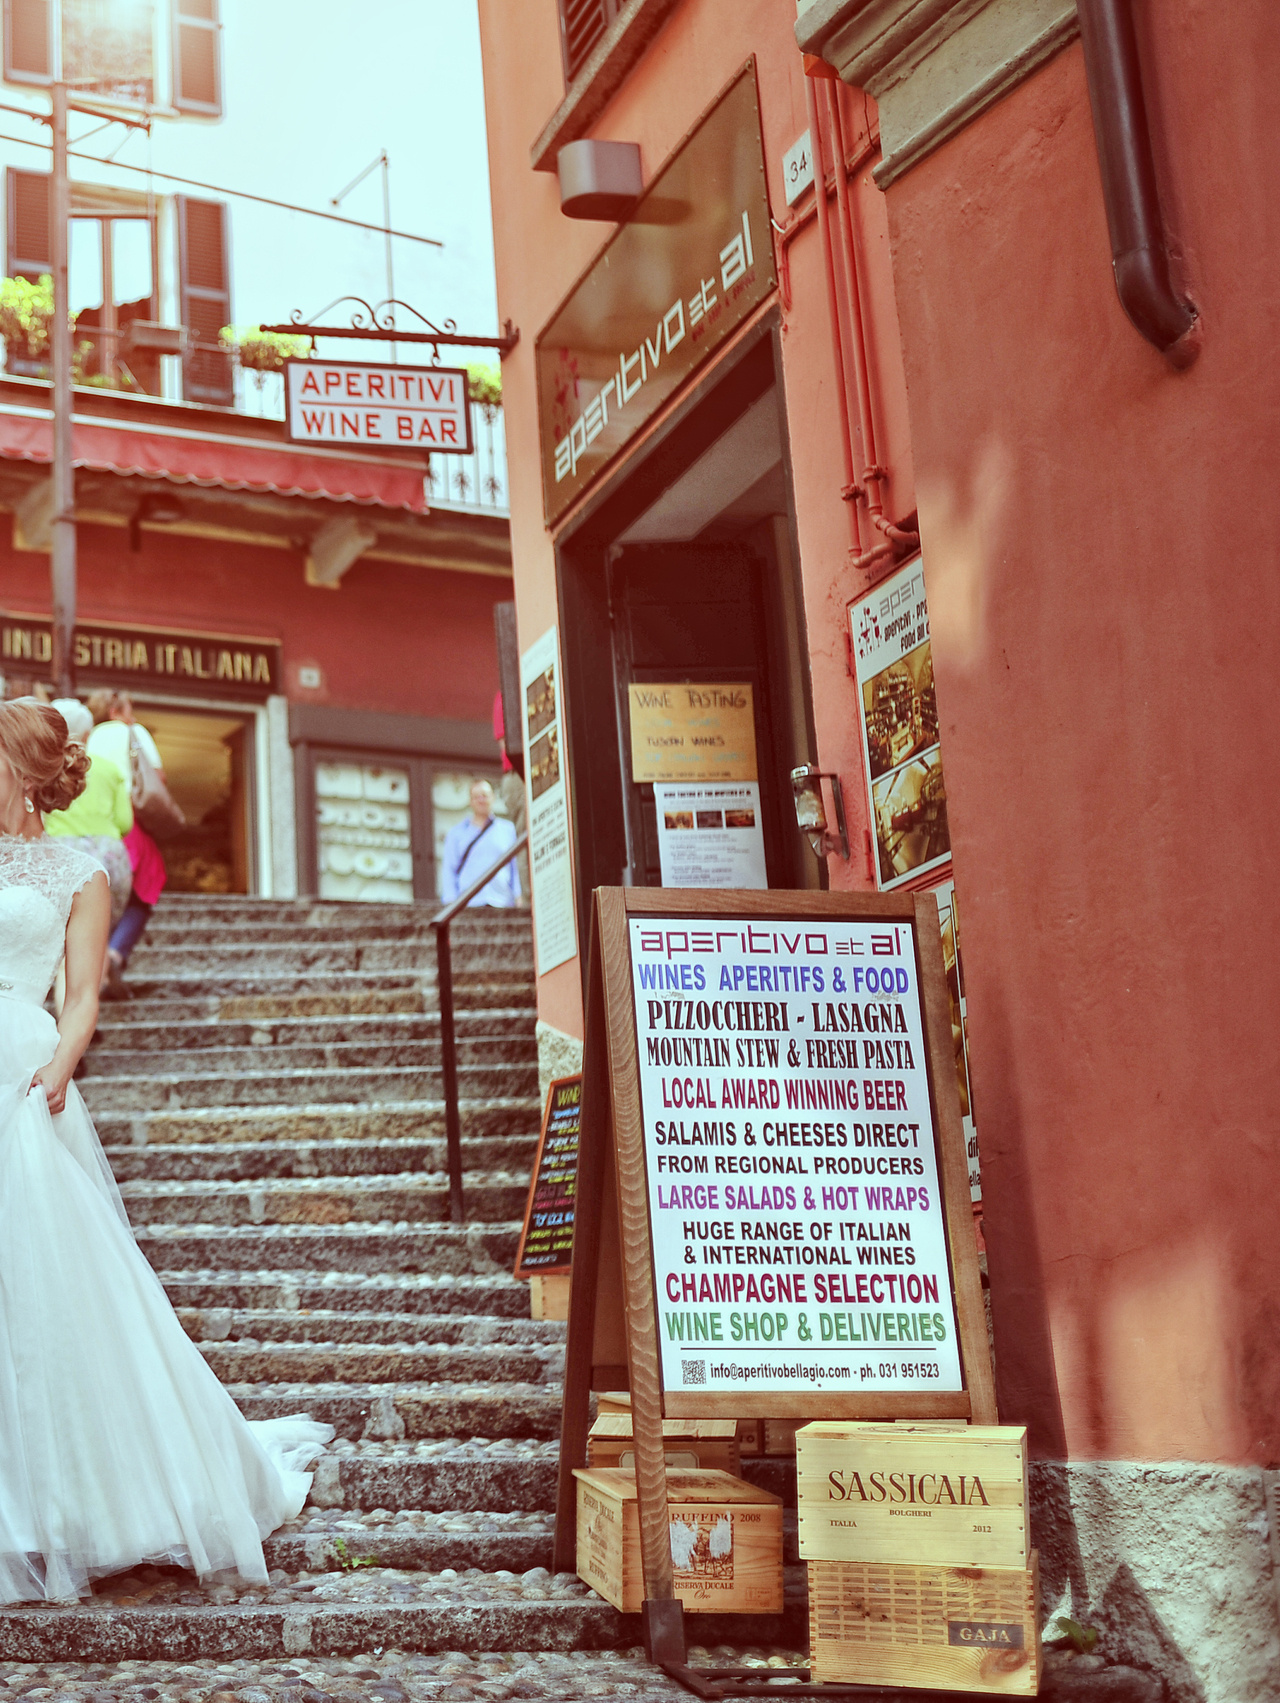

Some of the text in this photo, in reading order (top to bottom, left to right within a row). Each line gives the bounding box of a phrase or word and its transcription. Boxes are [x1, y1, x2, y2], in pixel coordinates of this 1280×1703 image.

[790, 150, 807, 182] 34
[720, 210, 754, 291] al
[301, 370, 455, 403] APERITIVI
[301, 410, 458, 444] WINE BAR
[2, 628, 148, 671] INDSTRIA
[685, 689, 747, 709] TASTING
[641, 925, 828, 959] aperitivo
[871, 927, 902, 956] al
[638, 964, 909, 993] WINES APERITIFS & FOOD
[647, 1000, 790, 1031] PIZZOCCHERI
[811, 1002, 908, 1033] LASAGNA
[646, 1037, 915, 1070] MOUNTAIN STEW & FRESH PASTA
[661, 1077, 908, 1111] LOCAL AWARD WINNING BEER
[655, 1121, 920, 1148] SALAMIS & CHEESES DIRECT
[657, 1155, 924, 1175] FROM REGIONAL PRODUCERS
[657, 1185, 930, 1211] LARGE SALADS & HOT WRAPS
[683, 1221, 911, 1241] HUGE RANGE OF ITALIAN
[684, 1245, 915, 1265] & INTERNATIONAL WINES
[665, 1272, 940, 1304] CHAMPAGNE SELECTION
[665, 1312, 947, 1342] WINE SHOP & DELIVERIES
[710, 1363, 850, 1382] info@aperitivobellagio.com
[860, 1363, 876, 1382] ph.
[879, 1363, 898, 1378] 031
[901, 1363, 940, 1379] 951523
[828, 1469, 991, 1506] SASSICAIA
[671, 1513, 761, 1522] RUFFINO 2008
[830, 1519, 857, 1528] ITALIA
[889, 1509, 932, 1517] BOLGHERI
[973, 1525, 992, 1533] 2012
[674, 1581, 734, 1590] RISERVA DUCALE
[960, 1627, 1012, 1643] GAJA
